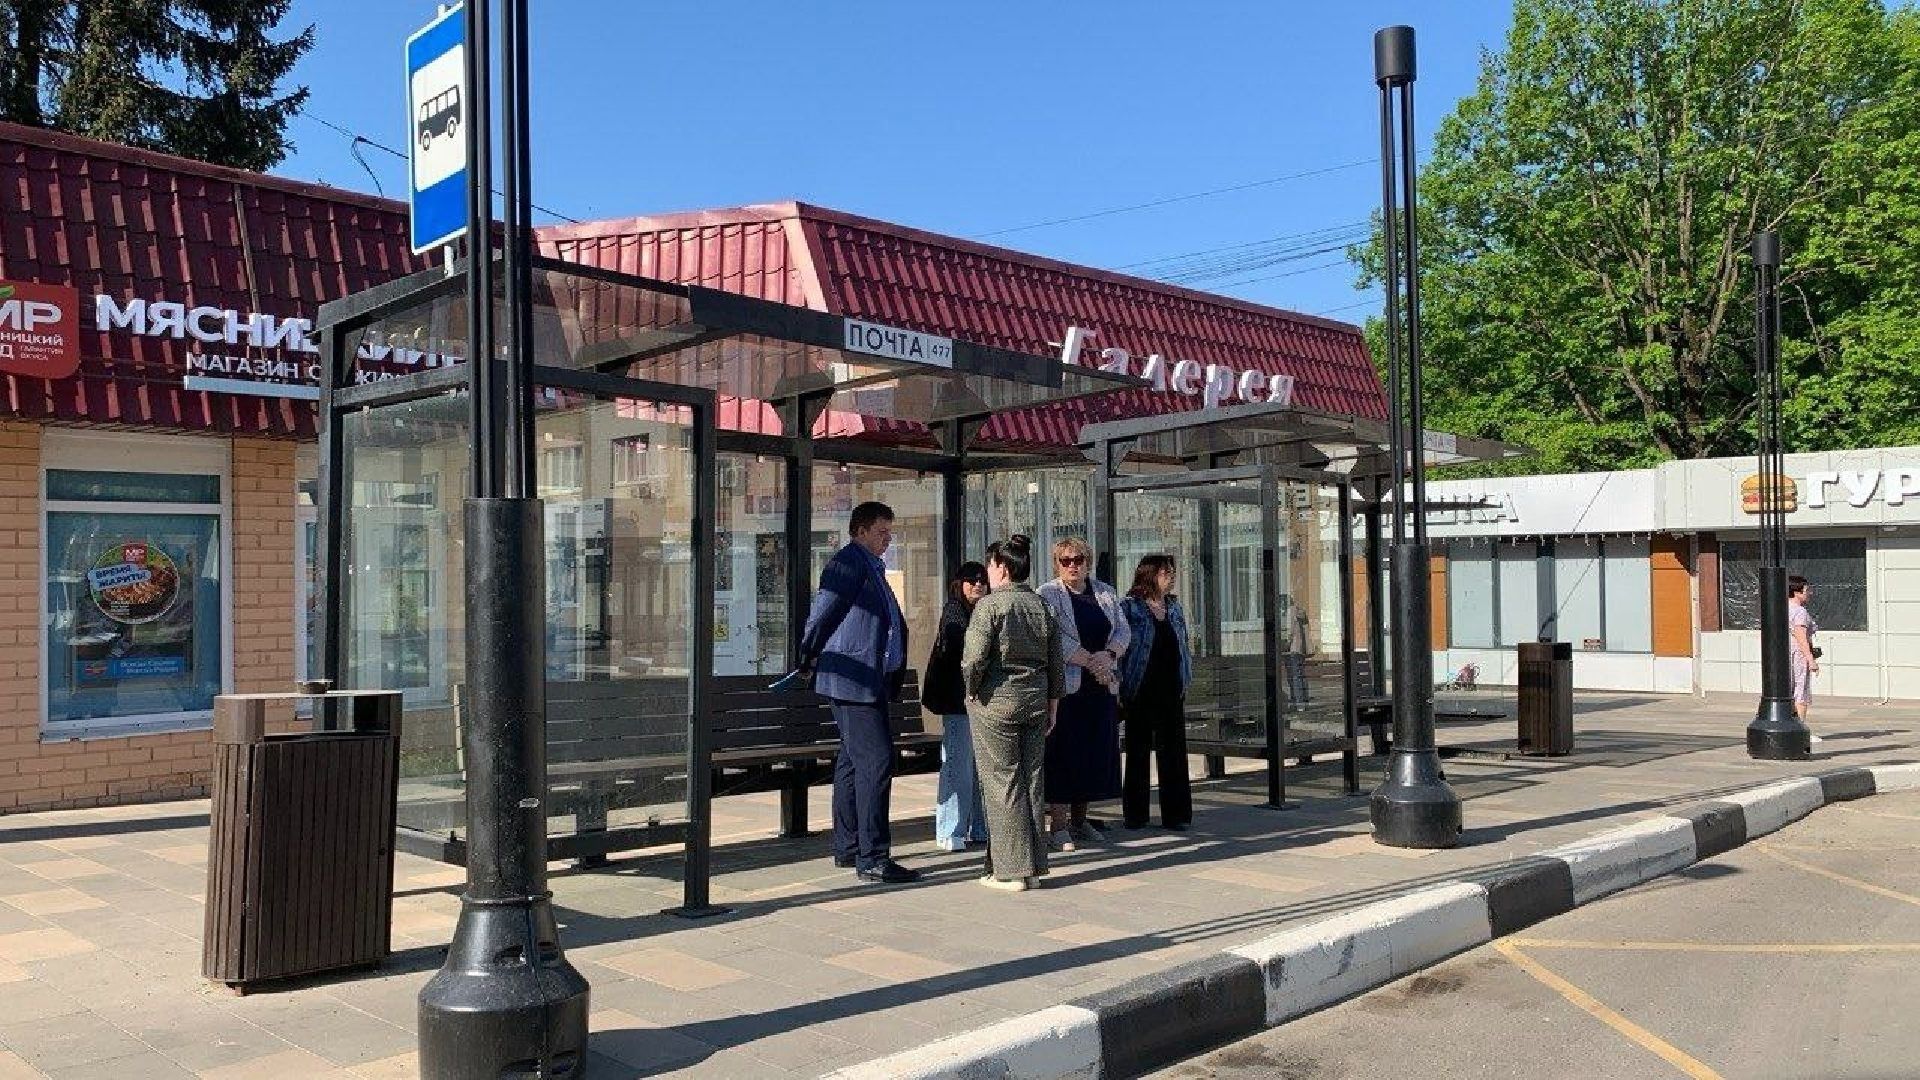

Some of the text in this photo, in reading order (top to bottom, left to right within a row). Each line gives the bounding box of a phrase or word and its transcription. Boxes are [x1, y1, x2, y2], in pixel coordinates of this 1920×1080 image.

[0, 332, 63, 346] НИЦКИЙ
[850, 323, 950, 358] ПОЧТА 477
[186, 351, 298, 378] МАГАЗИН
